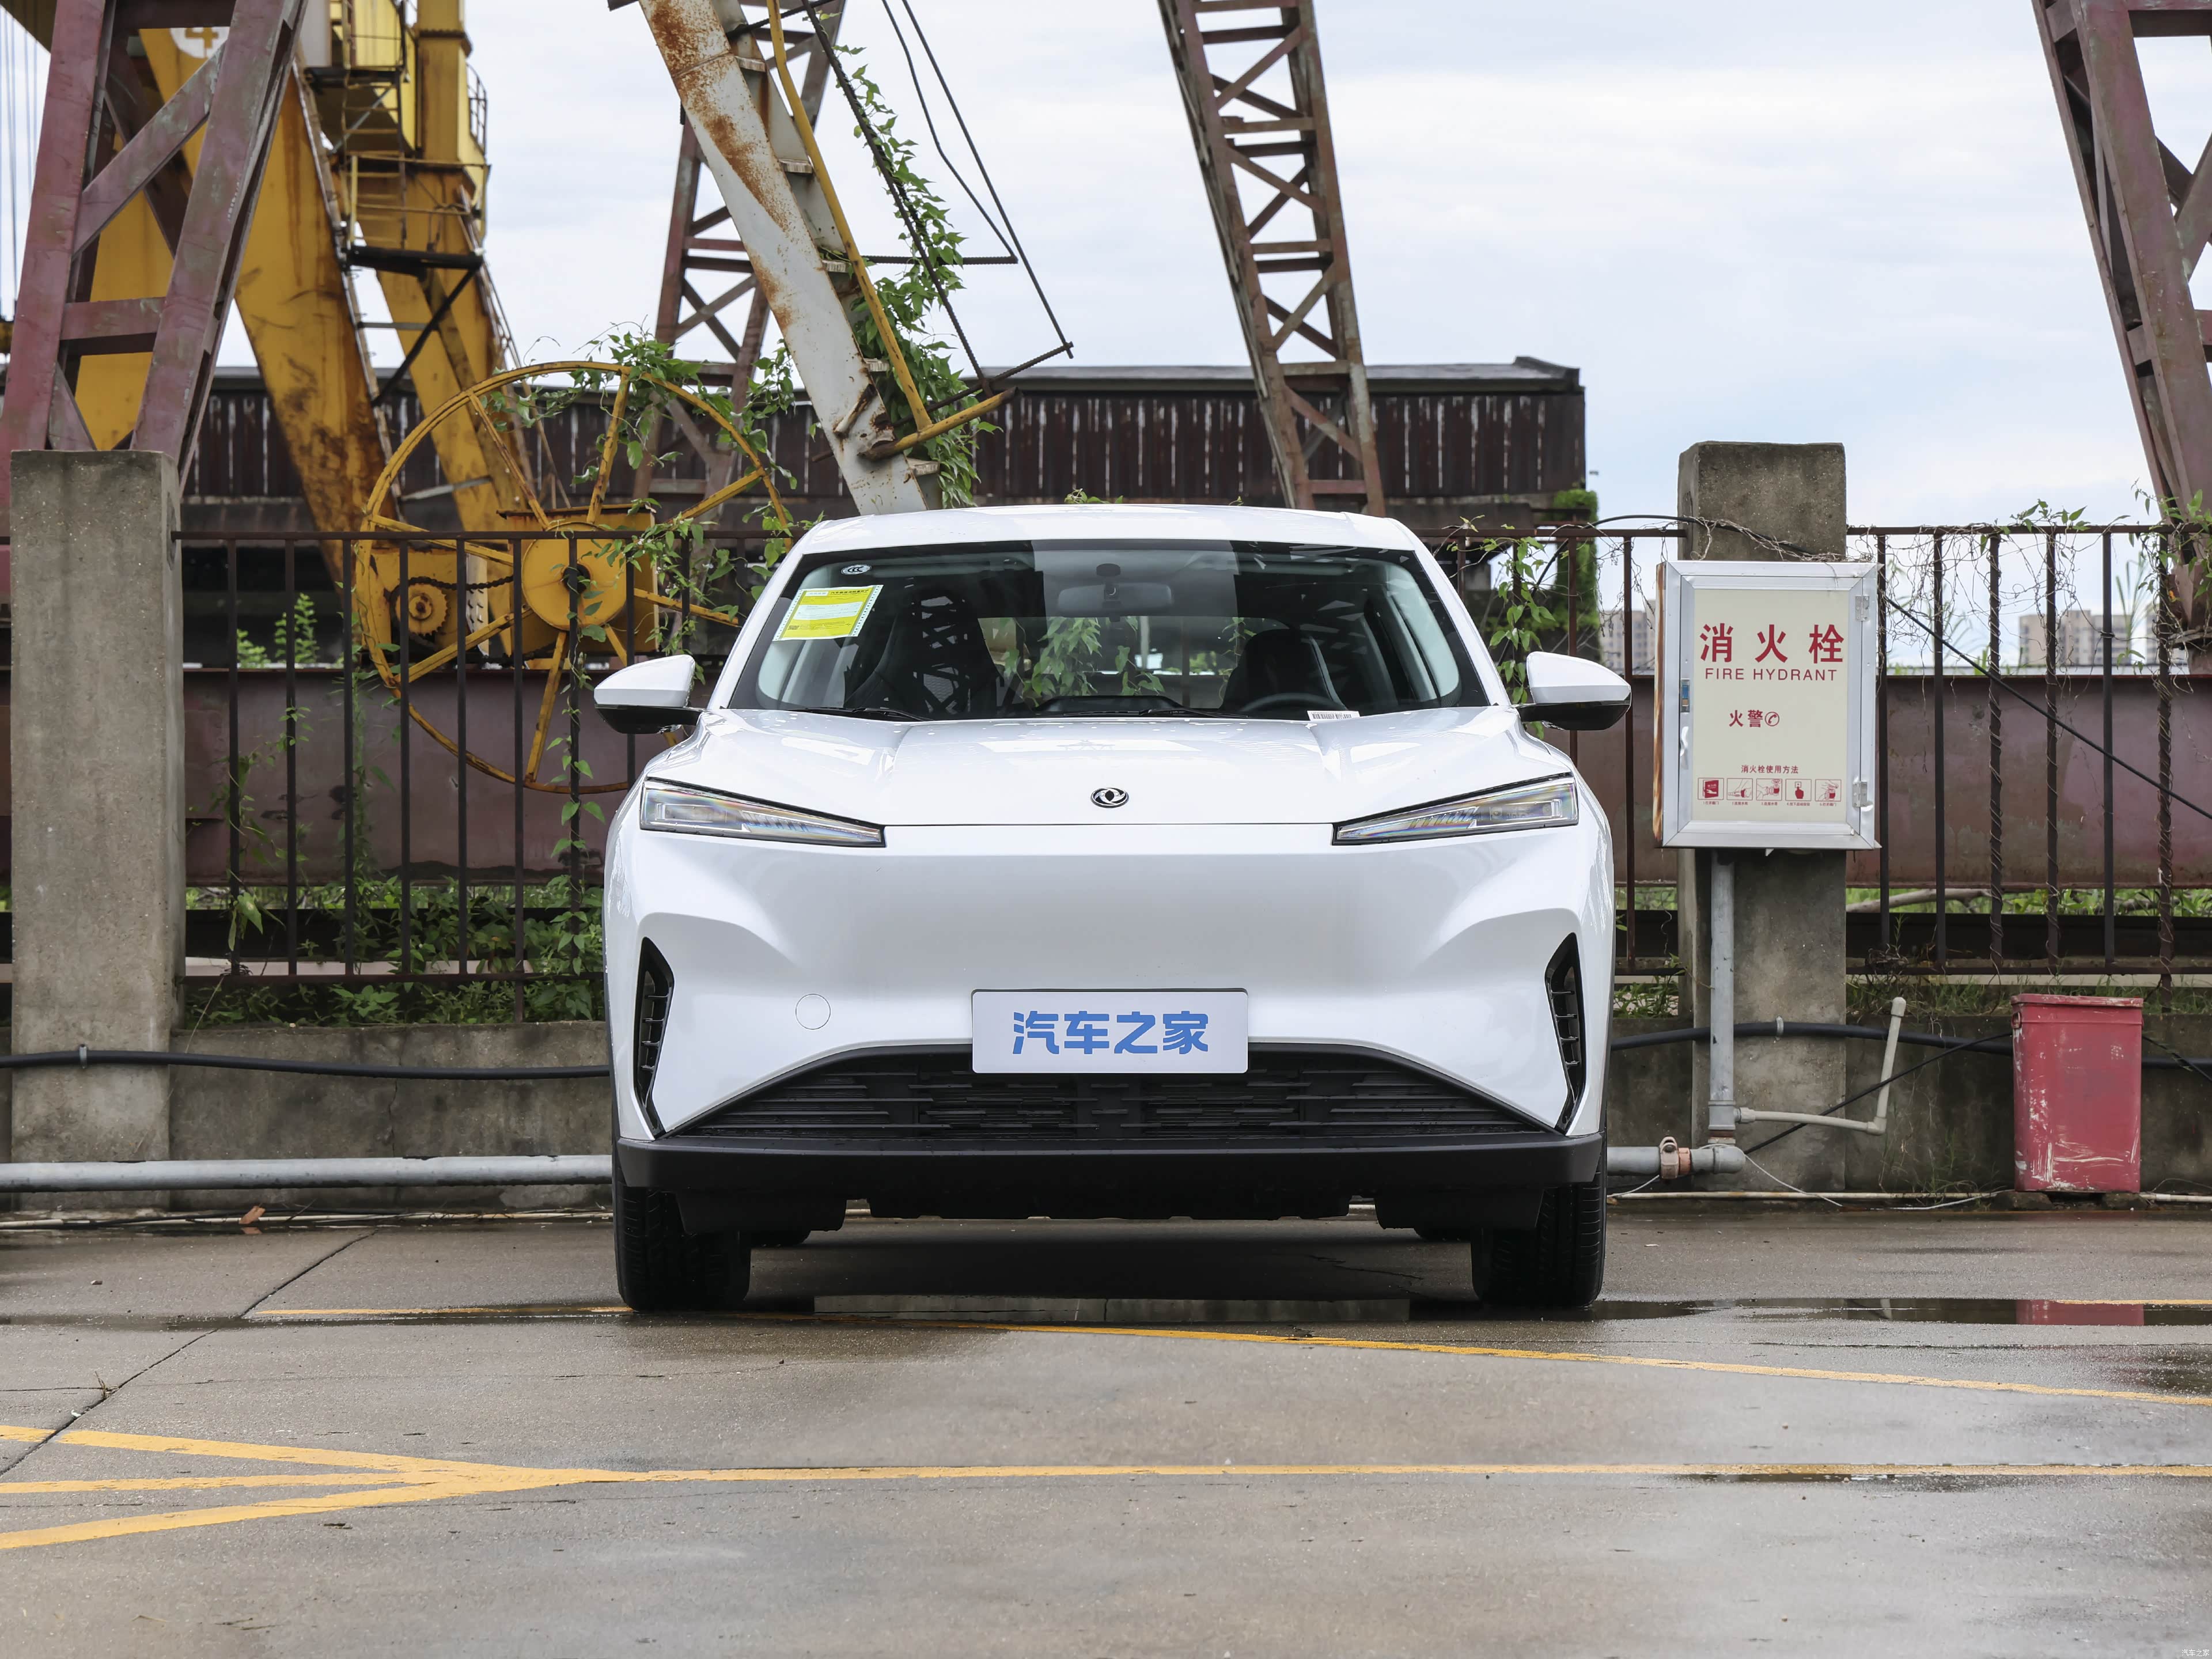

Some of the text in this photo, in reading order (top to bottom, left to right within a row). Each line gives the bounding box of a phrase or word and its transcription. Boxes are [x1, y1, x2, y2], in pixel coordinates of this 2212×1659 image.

[1700, 623, 1844, 664] 消火栓
[1705, 668, 1837, 681] FIRE HYDRANT
[1729, 710, 1763, 728] 火警
[1741, 764, 1798, 774] 消火栓使用方法
[1013, 1010, 1209, 1055] 汽车之家
